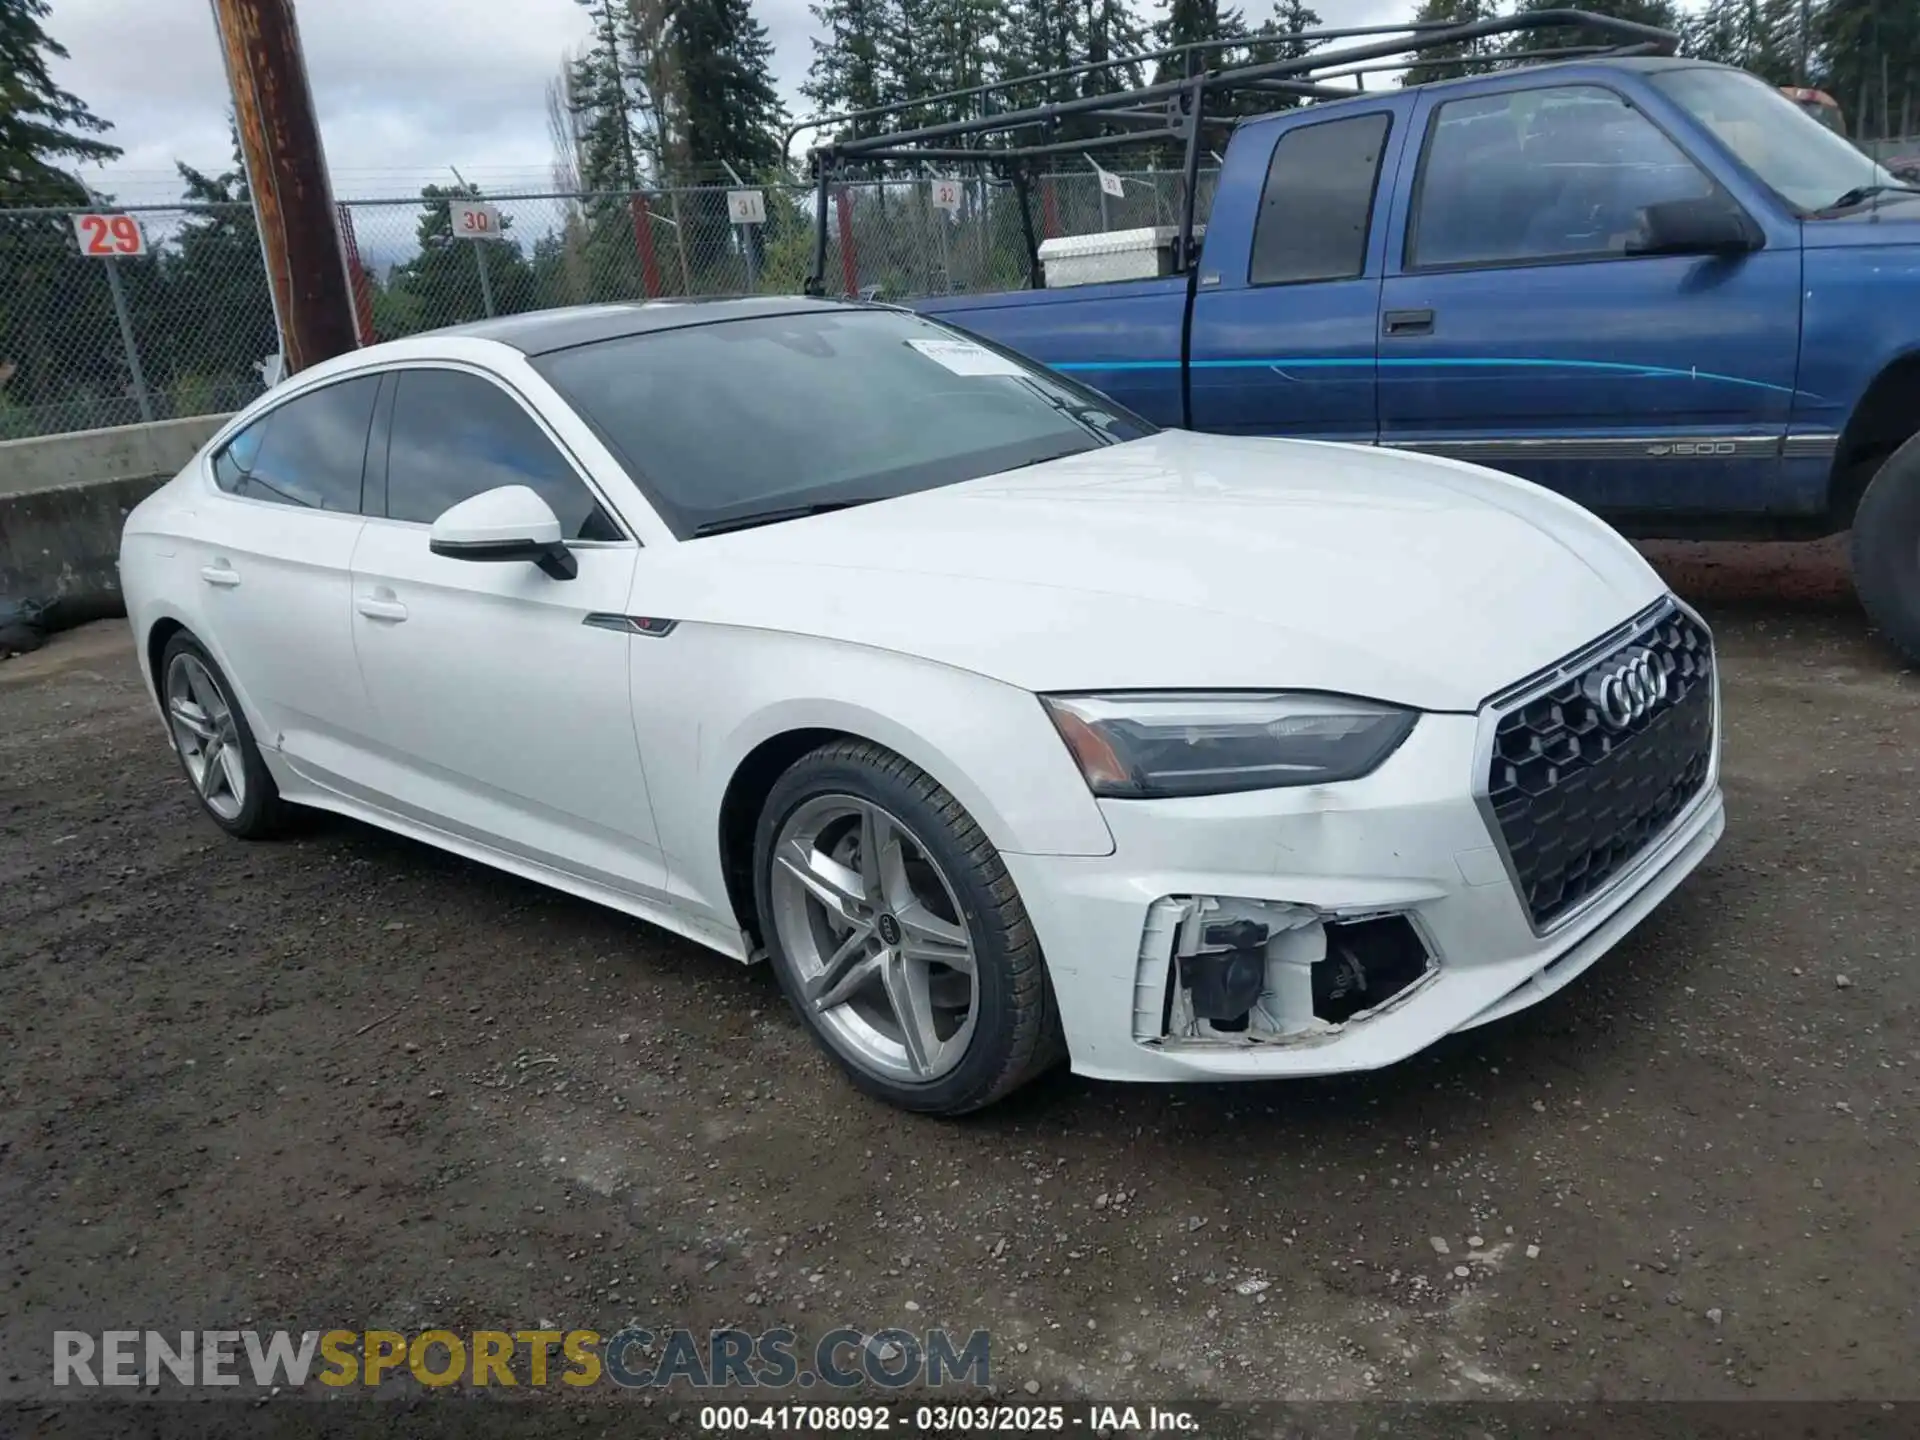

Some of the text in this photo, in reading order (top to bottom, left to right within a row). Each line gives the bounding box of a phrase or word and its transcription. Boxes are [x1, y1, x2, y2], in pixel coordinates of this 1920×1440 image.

[940, 187, 954, 203] 32
[738, 199, 756, 216] 31
[463, 211, 488, 231] 30
[81, 214, 139, 253] 29
[1671, 443, 1736, 455] 1500
